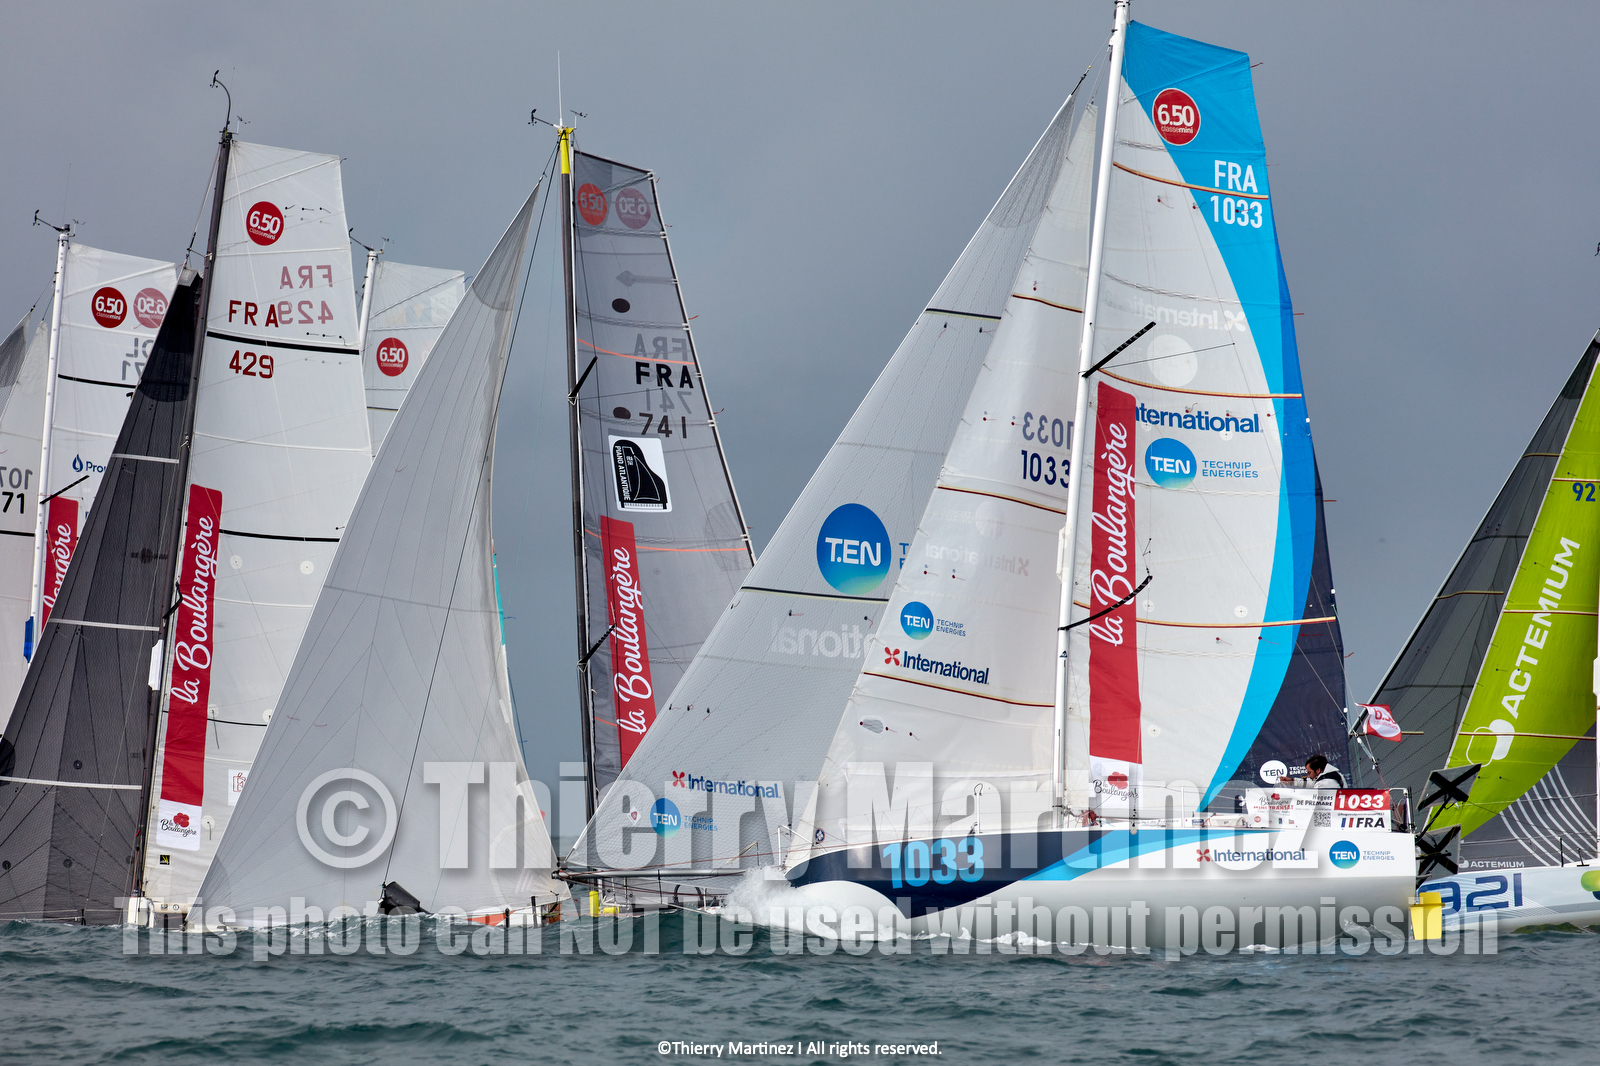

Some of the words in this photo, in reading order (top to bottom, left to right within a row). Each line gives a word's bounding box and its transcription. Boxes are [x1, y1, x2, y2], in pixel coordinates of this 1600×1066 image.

[1157, 103, 1195, 127] 6.50
[1160, 125, 1194, 134] classemini
[1214, 159, 1258, 193] FRA
[250, 210, 281, 235] 6.50
[1210, 195, 1263, 228] 1033
[95, 296, 124, 315] 6.50
[229, 300, 279, 328] FRA
[229, 350, 275, 379] 429
[379, 347, 405, 363] 6.50
[635, 361, 694, 389] FRA
[638, 412, 687, 439] 741
[1136, 402, 1260, 433] nternational
[615, 445, 625, 464] PIANO
[1150, 456, 1191, 474] T.EN
[1201, 460, 1252, 469] TECHNIP
[86, 461, 106, 473] Pro
[1020, 450, 1070, 489] 1033
[1201, 469, 1259, 478] ENERGIES
[618, 465, 631, 501] ATLANTIQUE
[1572, 482, 1600, 502] 92
[1090, 422, 1135, 606] Boulangère
[825, 537, 882, 567] T.EN
[175, 515, 218, 671] Boulangère
[610, 546, 652, 703] Boulangère
[904, 614, 930, 629] T.EN
[936, 618, 964, 628] TECHNIP
[936, 625, 967, 637] ENERGIES
[1089, 615, 1123, 647] la
[1501, 536, 1580, 719] ACTEMIUM
[902, 650, 989, 685] International
[170, 678, 200, 704] la
[617, 708, 647, 734] la
[1263, 768, 1284, 777] T.EN
[688, 774, 780, 799] International
[1338, 794, 1384, 809] 1033
[653, 812, 678, 826] T.EN
[683, 822, 718, 831] ENERGIES
[684, 815, 714, 824] TECHNIP
[1356, 817, 1386, 828] FRA
[883, 836, 985, 889] 1033
[1214, 848, 1306, 862] International
[1332, 850, 1357, 860] T.EN
[1470, 860, 1525, 868] ACTEMIUM
[1418, 872, 1523, 917] 921
